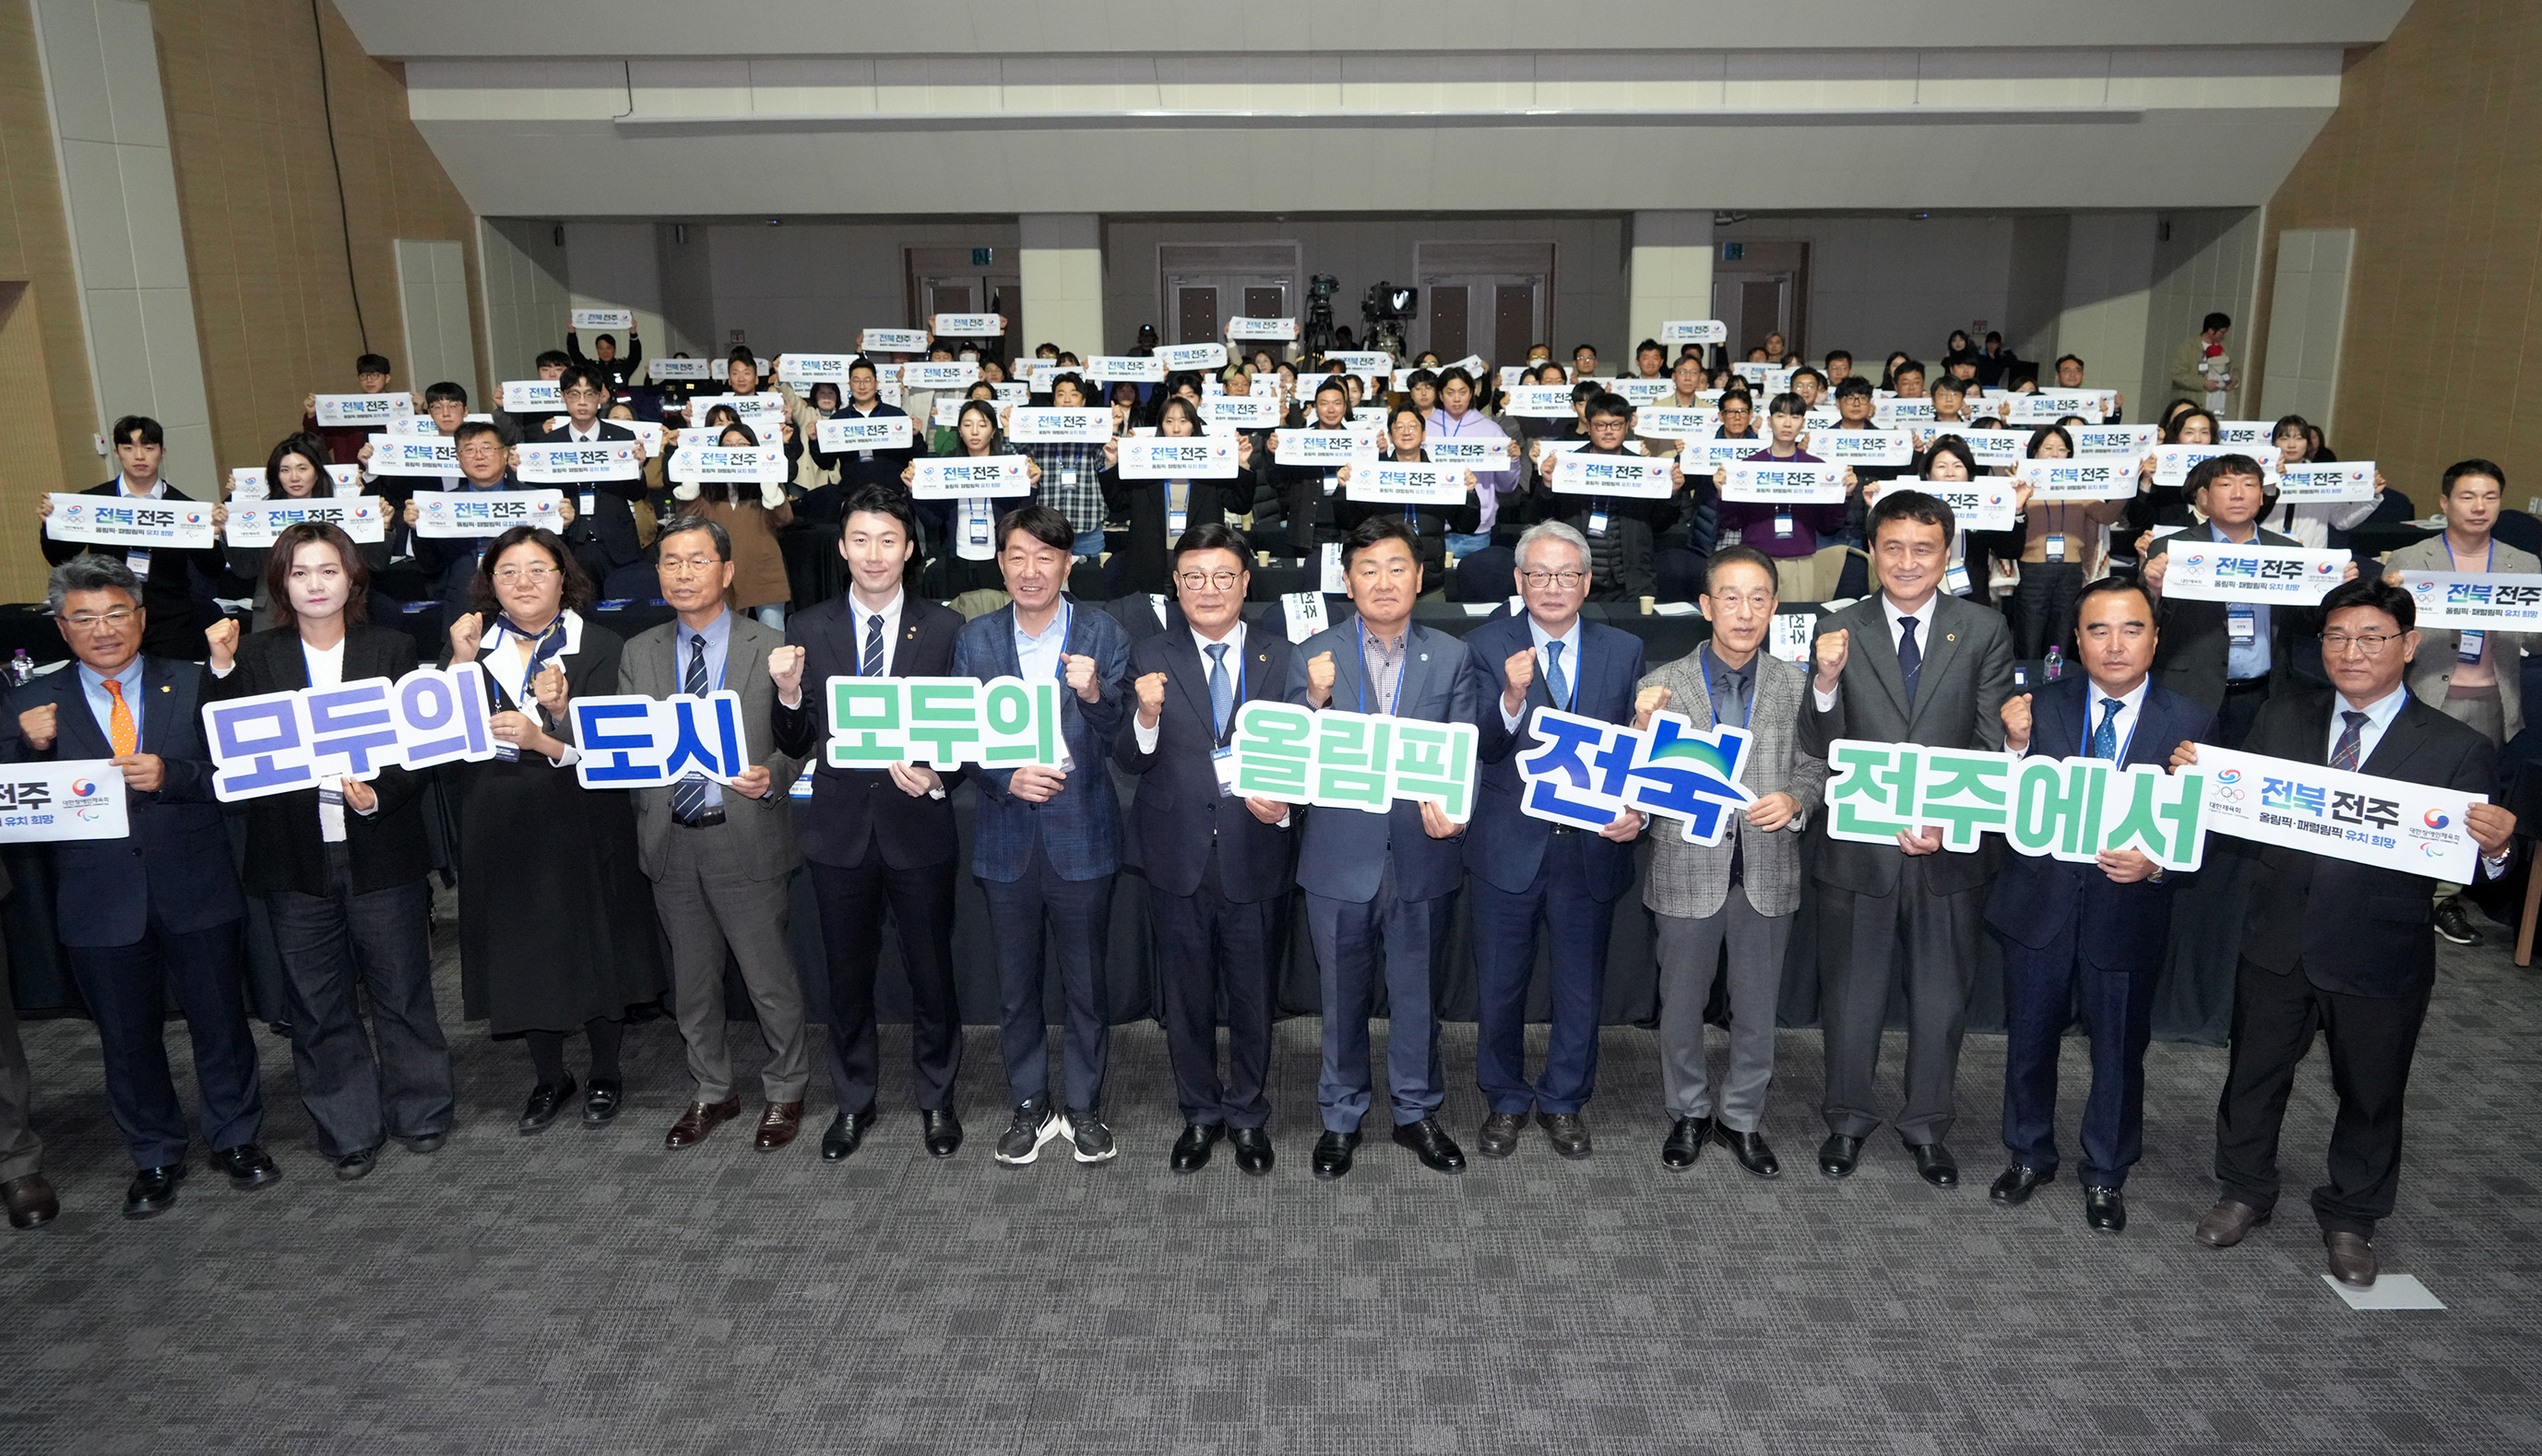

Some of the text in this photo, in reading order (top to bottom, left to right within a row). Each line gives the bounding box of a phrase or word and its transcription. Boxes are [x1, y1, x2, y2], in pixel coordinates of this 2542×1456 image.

[1246, 321, 1278, 329] 전북 전주
[880, 334, 911, 343] 전북 전주
[1173, 349, 1208, 361] 전북 전주
[801, 361, 841, 371] 전북 전주
[1108, 361, 1144, 371] 전북 전주
[924, 368, 960, 378] 전북 전주
[529, 387, 552, 398] 전북
[1629, 385, 1647, 395] 전북
[1531, 393, 1551, 404] 전북
[2033, 399, 2079, 410] 전북 전주
[341, 400, 389, 412] 전북 전주
[739, 401, 760, 411] 전주
[1216, 404, 1257, 414] 전북 전주
[1896, 406, 1917, 415] 전북
[1038, 416, 1087, 428] 전북 전주
[1658, 415, 1704, 426] 전북 전주
[1807, 419, 1828, 429] 전주
[843, 424, 887, 437] 전북 전주
[2230, 430, 2254, 441] 전주
[1303, 437, 1352, 450] 전북 전주
[1835, 438, 1886, 450] 전북 전주
[1990, 438, 2014, 450] 전주
[2082, 433, 2131, 446] 전북 전주
[404, 445, 433, 459] 전북
[1151, 447, 1207, 461] 전북 전주
[1435, 444, 1485, 456] 전북 전주
[1709, 447, 1733, 459] 전북
[550, 450, 609, 464] 전북 전주
[701, 453, 756, 465] 전북 전주
[943, 467, 1000, 481] 전북 전주
[1586, 465, 1643, 479] 전북 전주
[2049, 468, 2109, 482] 전북 전주
[1379, 472, 1436, 487] 전북 전주
[1756, 471, 1815, 486] 전북 전주
[2282, 472, 2343, 487] 전북 전주
[1946, 494, 1978, 509] 전주
[454, 502, 527, 518] 전북 전주
[95, 507, 174, 527] 전북 전주
[268, 510, 304, 527] 전북
[2215, 557, 2304, 579] 전북 전주
[2214, 580, 2300, 592] 올림픽·패럴림픽 유치 희망
[2447, 583, 2541, 607] 전북 전주
[2446, 607, 2538, 618] 올림픽·패럴림픽 유치 희망
[834, 683, 1054, 764] 모두의
[214, 670, 488, 793] 모두의
[577, 698, 738, 782] 도시
[1239, 706, 1470, 817] 올림픽
[1525, 716, 1754, 839] 전북
[1834, 747, 2203, 864] 전주에서
[2209, 802, 2241, 813] 대한체육회
[2262, 776, 2400, 830] 전북 전주
[5, 815, 53, 826] 유치 희망
[2260, 811, 2343, 839] 올림픽·패럴림픽
[2345, 830, 2369, 844] 유치
[2371, 835, 2396, 848] 희망
[2409, 826, 2460, 841] 대한장애인체육회
